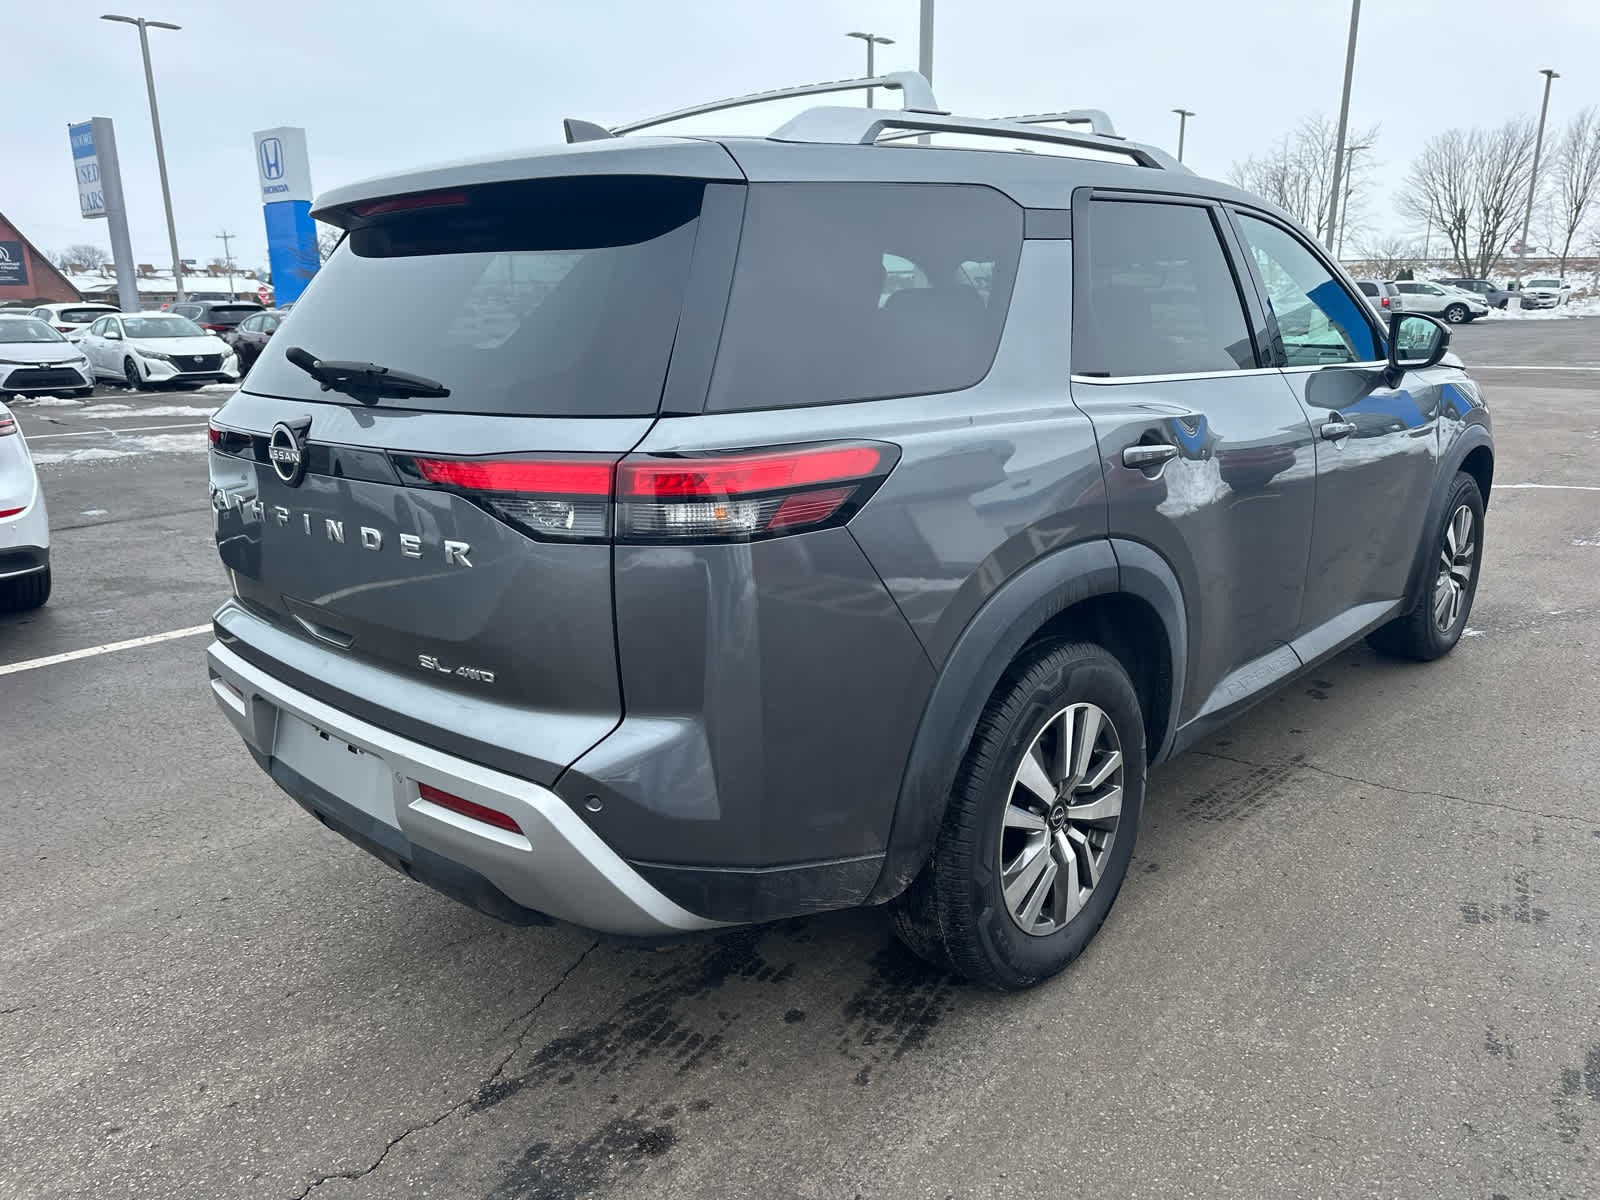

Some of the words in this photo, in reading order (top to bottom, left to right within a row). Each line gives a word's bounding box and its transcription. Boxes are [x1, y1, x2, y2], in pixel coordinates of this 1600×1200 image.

[76, 163, 99, 184] USED
[263, 184, 289, 195] HONDA
[80, 190, 104, 211] CARS
[418, 654, 451, 673] SL
[456, 666, 495, 684] 4WD
